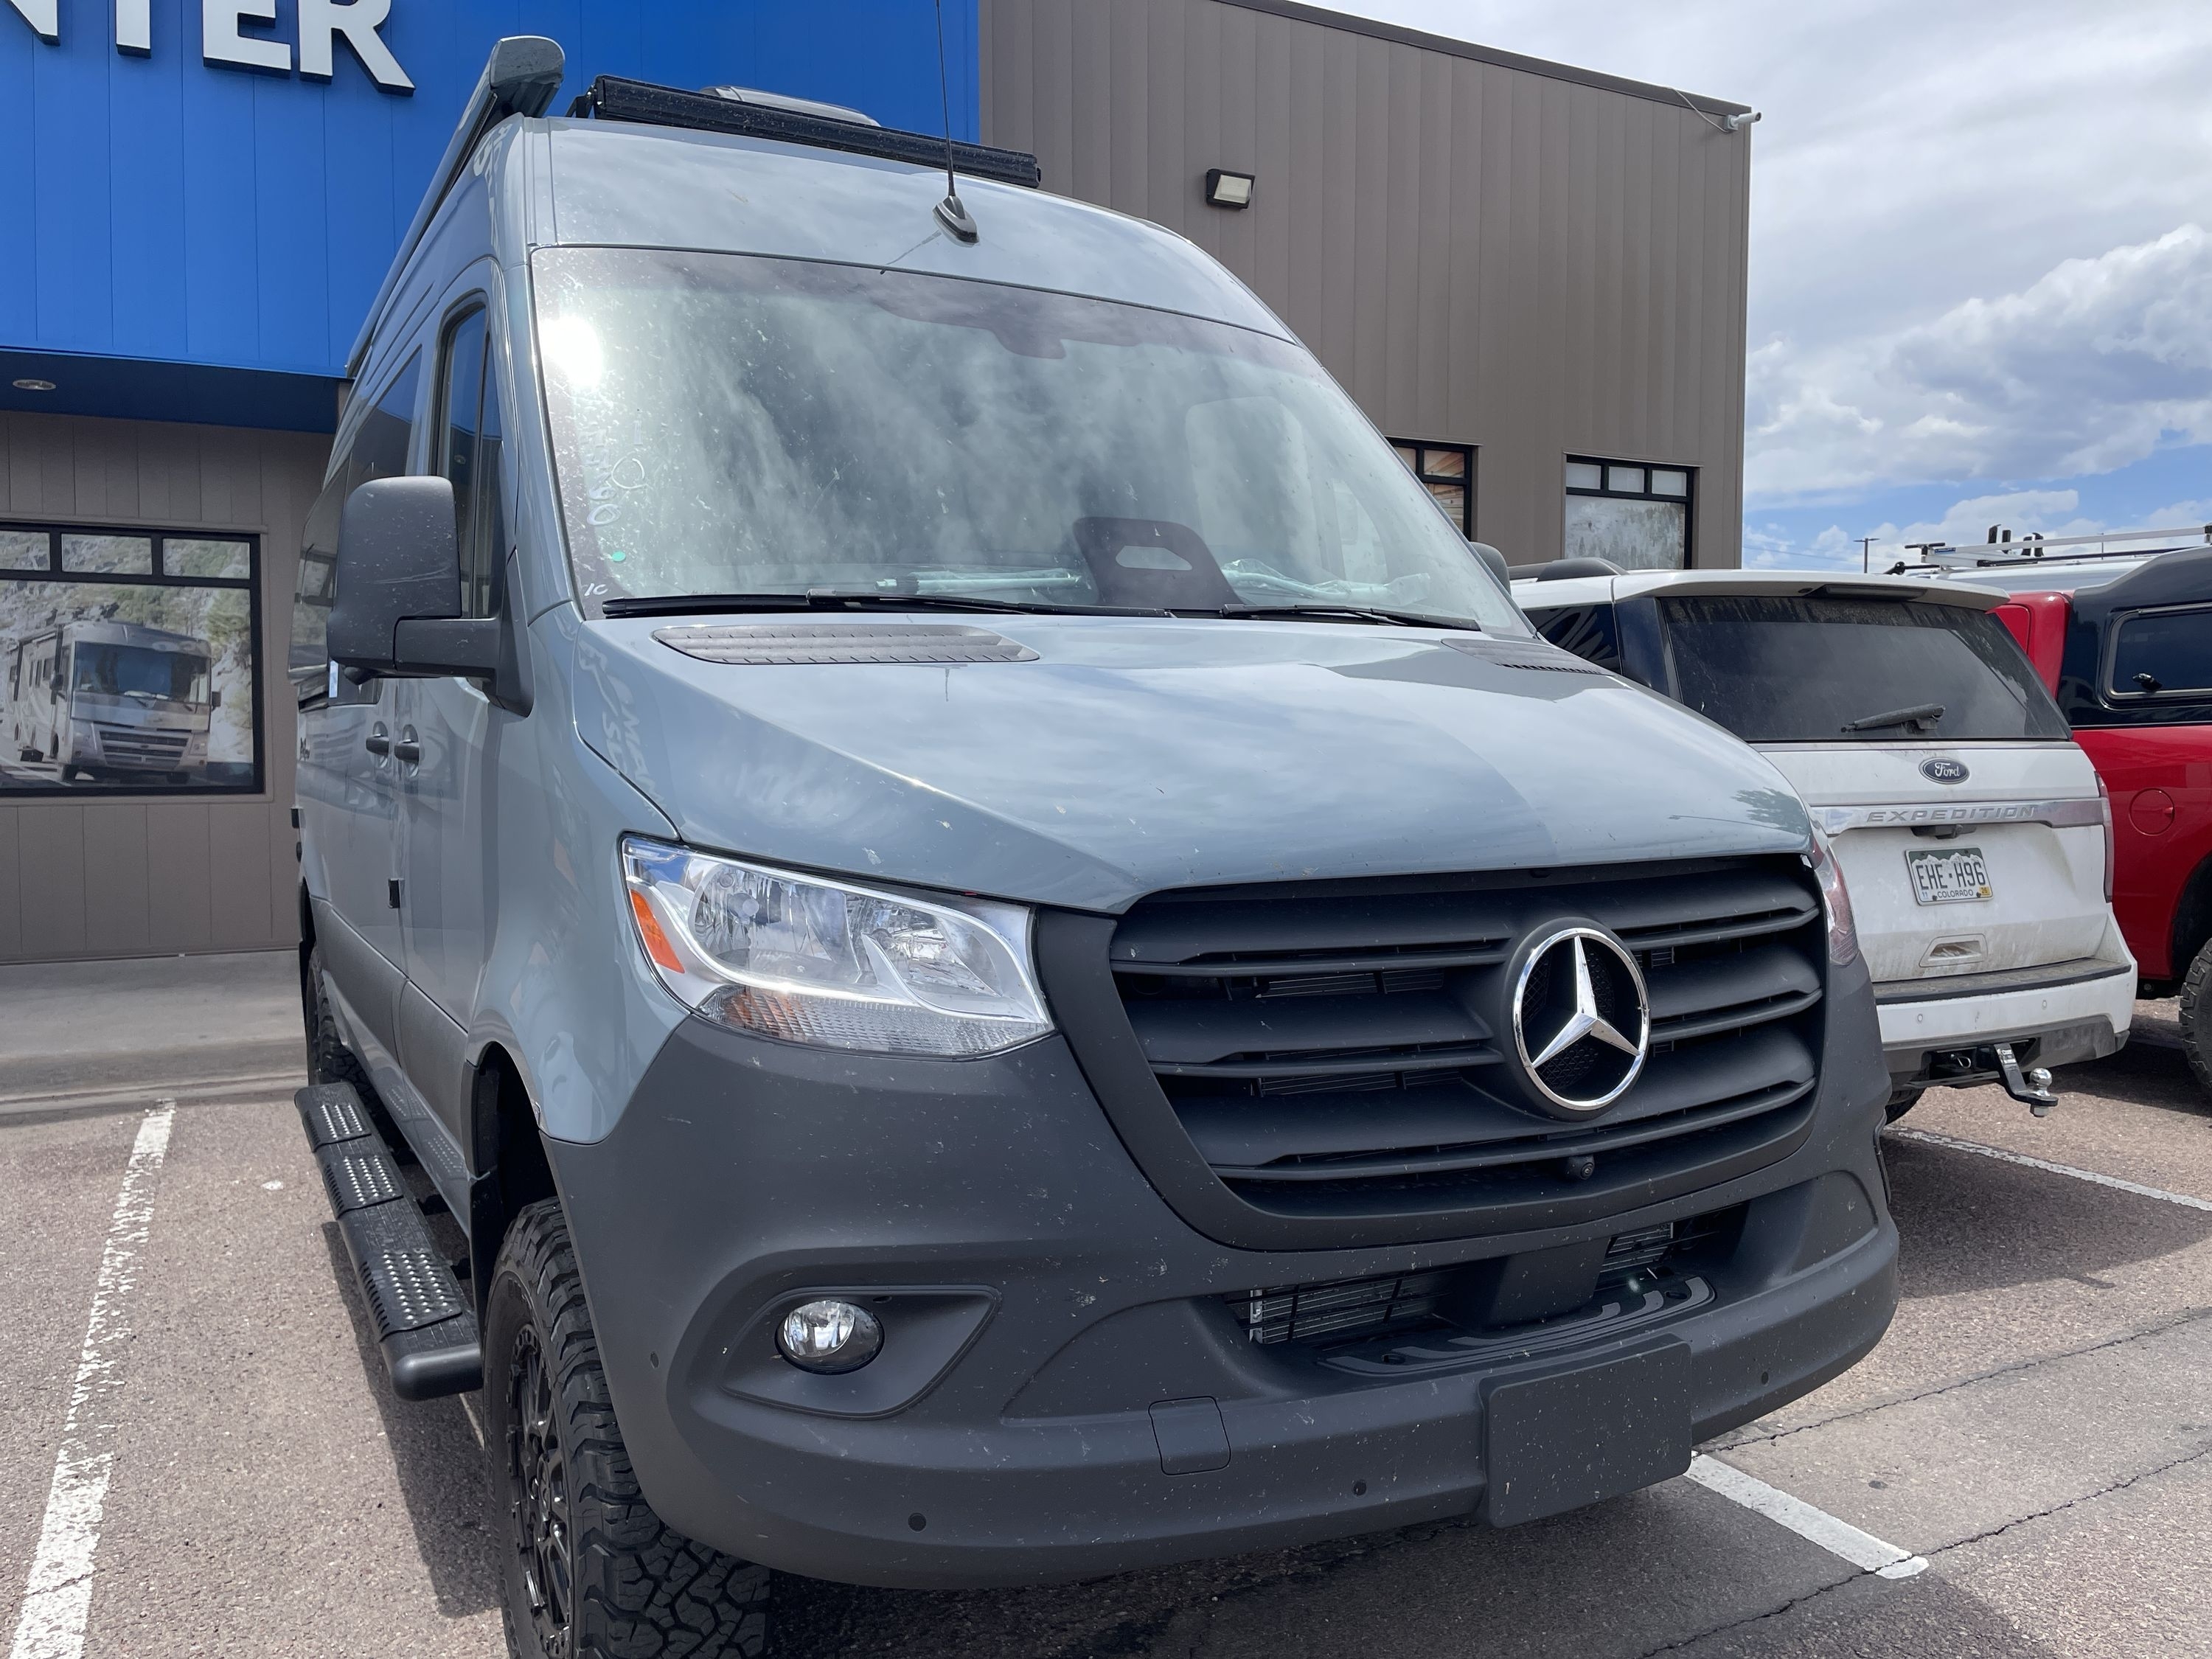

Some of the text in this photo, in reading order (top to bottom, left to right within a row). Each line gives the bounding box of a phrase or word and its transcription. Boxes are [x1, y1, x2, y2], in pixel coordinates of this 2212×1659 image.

[1934, 762, 1961, 777] Ford
[1866, 806, 2036, 823] EXPEDITION
[1937, 888, 1974, 899] COLORADO
